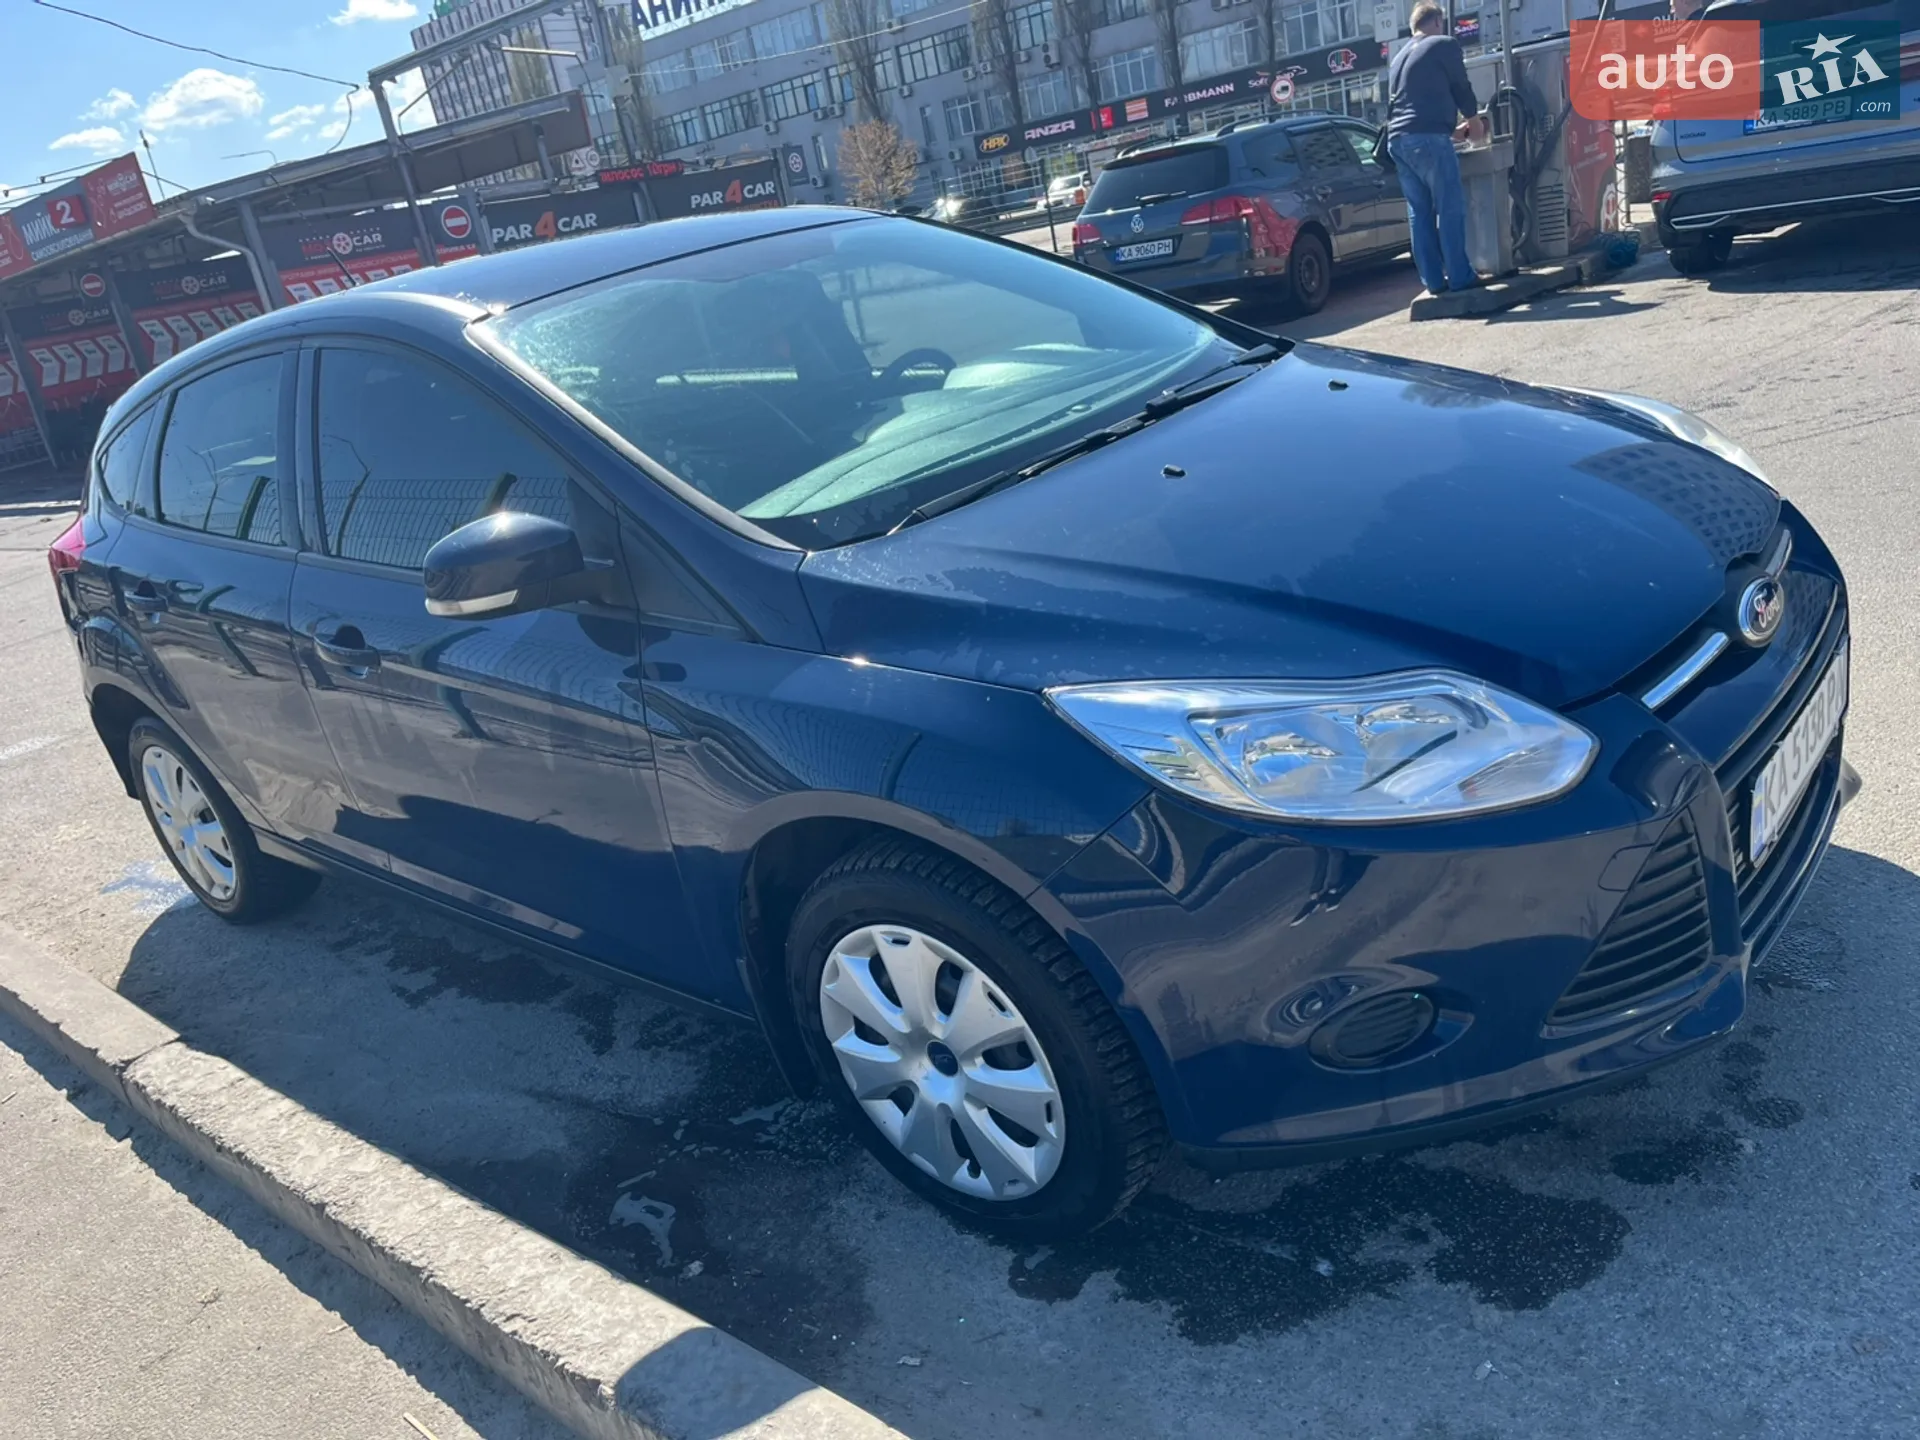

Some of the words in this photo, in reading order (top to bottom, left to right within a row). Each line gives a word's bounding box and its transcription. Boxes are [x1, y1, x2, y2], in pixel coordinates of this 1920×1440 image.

[1381, 20, 1391, 29] 10
[1784, 104, 1819, 122] 5889
[1822, 100, 1846, 117] PB
[1024, 120, 1076, 140] ANZA
[56, 200, 76, 225] 2
[21, 211, 66, 246] МИЙК
[353, 233, 382, 246] CAR
[1120, 247, 1133, 259] KA
[1135, 244, 1156, 257] 9060
[1763, 751, 1788, 830] KA
[1793, 692, 1825, 781] 5138
